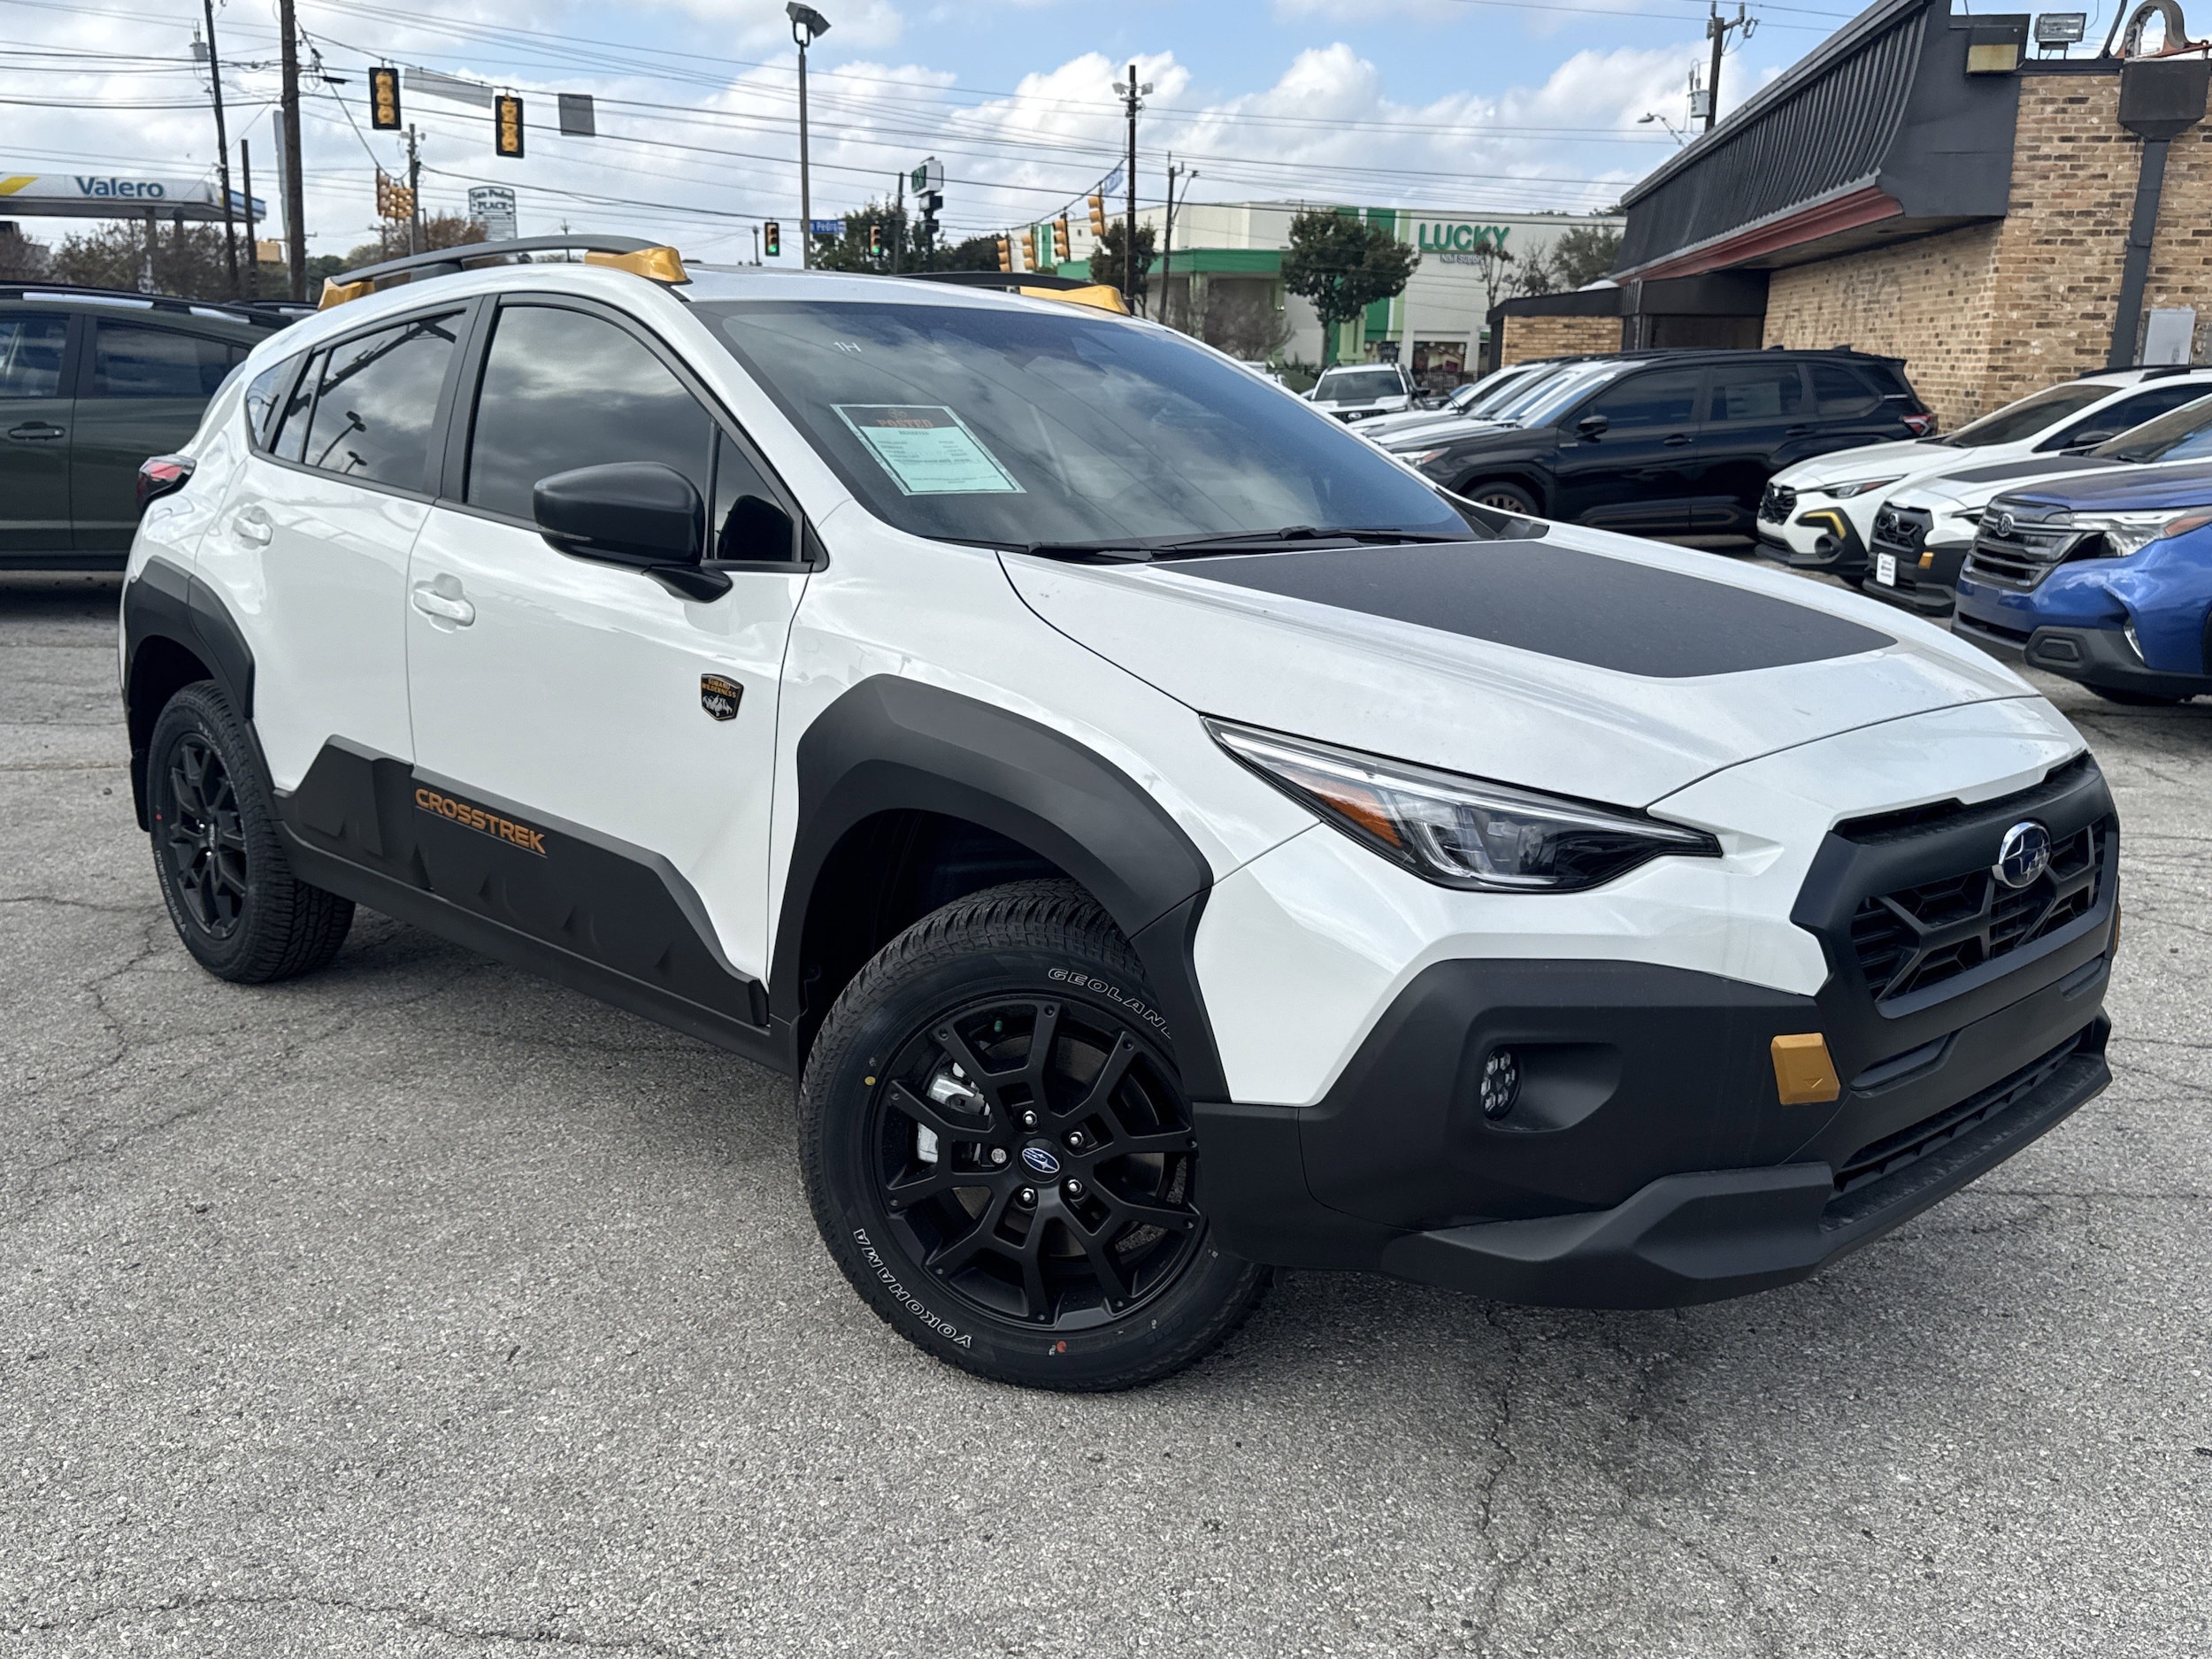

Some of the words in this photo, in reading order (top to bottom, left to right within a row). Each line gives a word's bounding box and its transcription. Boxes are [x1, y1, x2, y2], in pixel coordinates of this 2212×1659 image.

[76, 177, 165, 199] Valero
[478, 201, 508, 211] PLACE
[1418, 223, 1510, 251] LUCKY
[701, 682, 737, 699] WILDERNESS
[709, 678, 731, 690] SUBARU
[415, 788, 547, 855] CROSSTREK
[853, 1228, 972, 1349] YOKOHAMA
